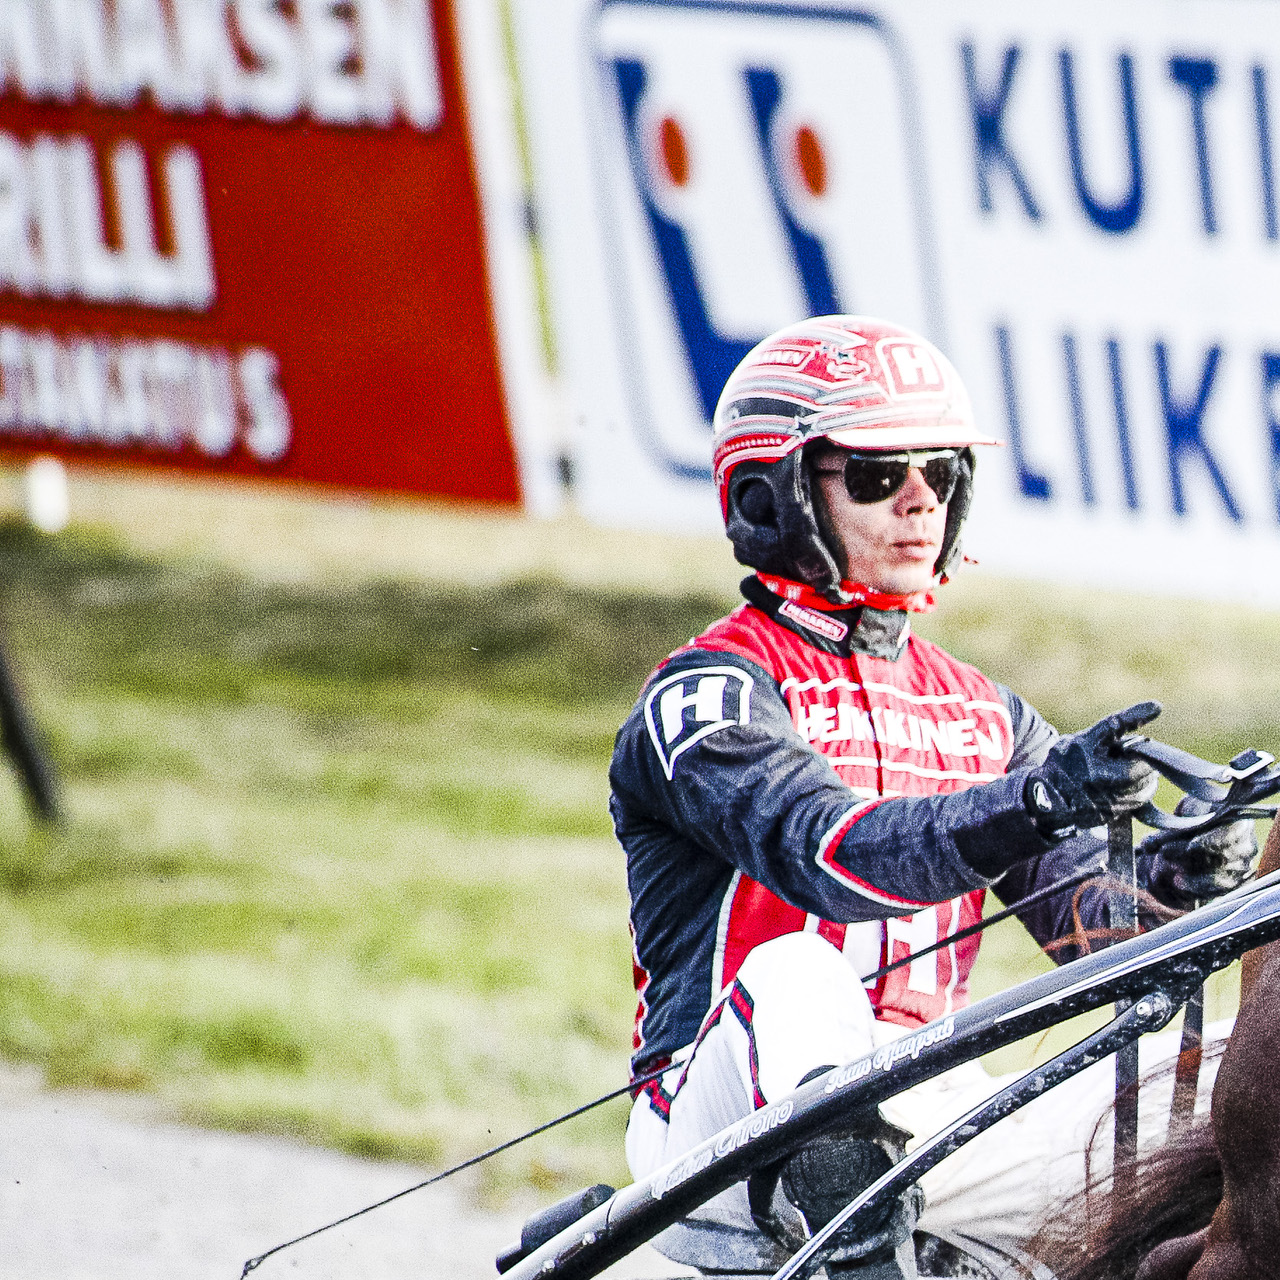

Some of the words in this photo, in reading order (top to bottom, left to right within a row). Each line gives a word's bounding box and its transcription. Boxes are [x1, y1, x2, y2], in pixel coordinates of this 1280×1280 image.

[891, 346, 941, 386] H
[661, 676, 728, 745] H
[799, 701, 1003, 761] HEIKKINEN
